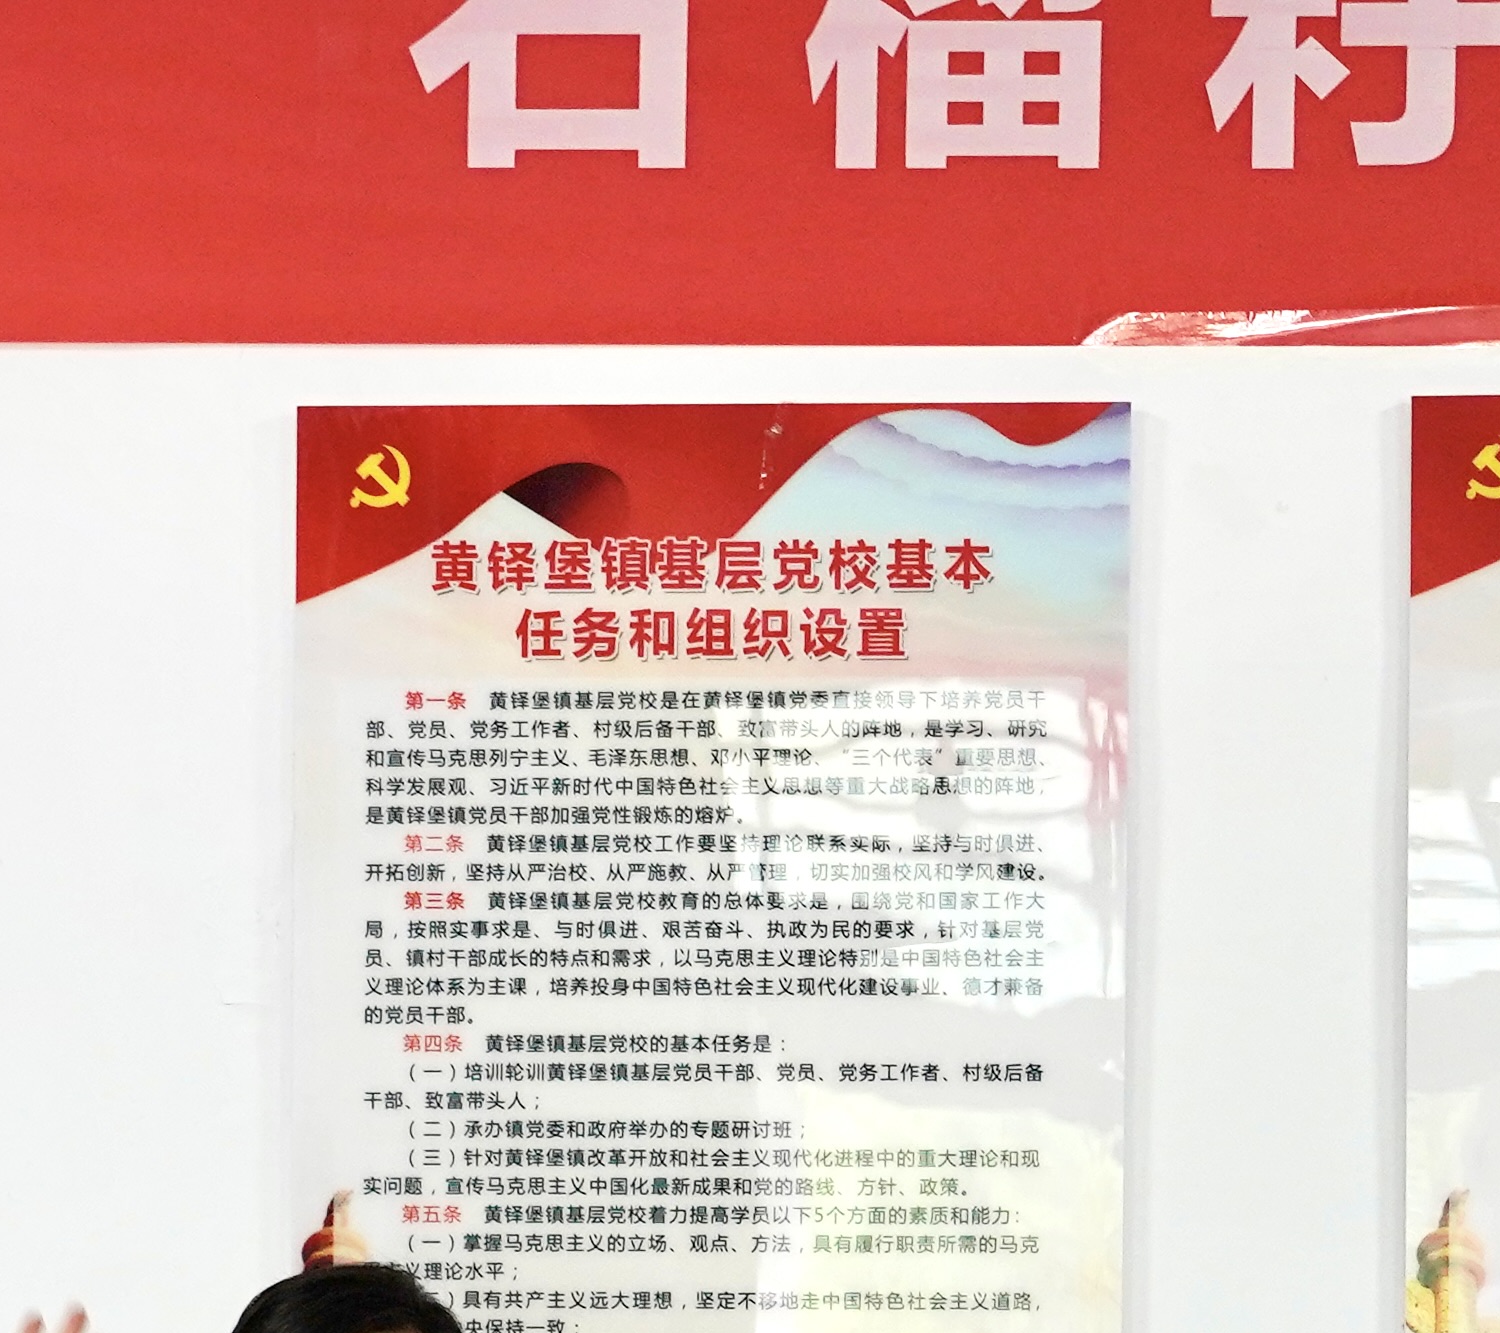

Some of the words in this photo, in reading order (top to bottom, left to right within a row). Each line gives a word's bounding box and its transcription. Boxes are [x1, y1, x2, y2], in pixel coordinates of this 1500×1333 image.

[430, 538, 993, 592] 黄铎堡镇基层党校基本
[516, 607, 907, 659] 任务和组织设置
[405, 691, 466, 710] 第一条
[490, 691, 1043, 709] 黄铎堡镇基层党校是在黄铎堡镇党委直接领导下培养党员干
[405, 835, 463, 853] 第二条
[487, 834, 1042, 853] 黄铎堡镇基层党校工作要坚持理论联系实际，坚持与时俱进、
[404, 891, 464, 910] 第三条
[488, 891, 1044, 910] 黄铎堡镇基层党校教育的总体要求是，围绕党和国家工作大
[365, 1006, 473, 1024] 的党员干部。
[403, 1034, 462, 1052] 第四条
[485, 1034, 784, 1053] 黄铎堡镇基层党校的基本任务是：
[364, 1091, 538, 1110] 干部、致富带头人；
[402, 1205, 461, 1223] 第五条
[485, 1205, 1018, 1224] 黄铎堡镇基层党校着力提高学员以下5个方面的素质和能力：
